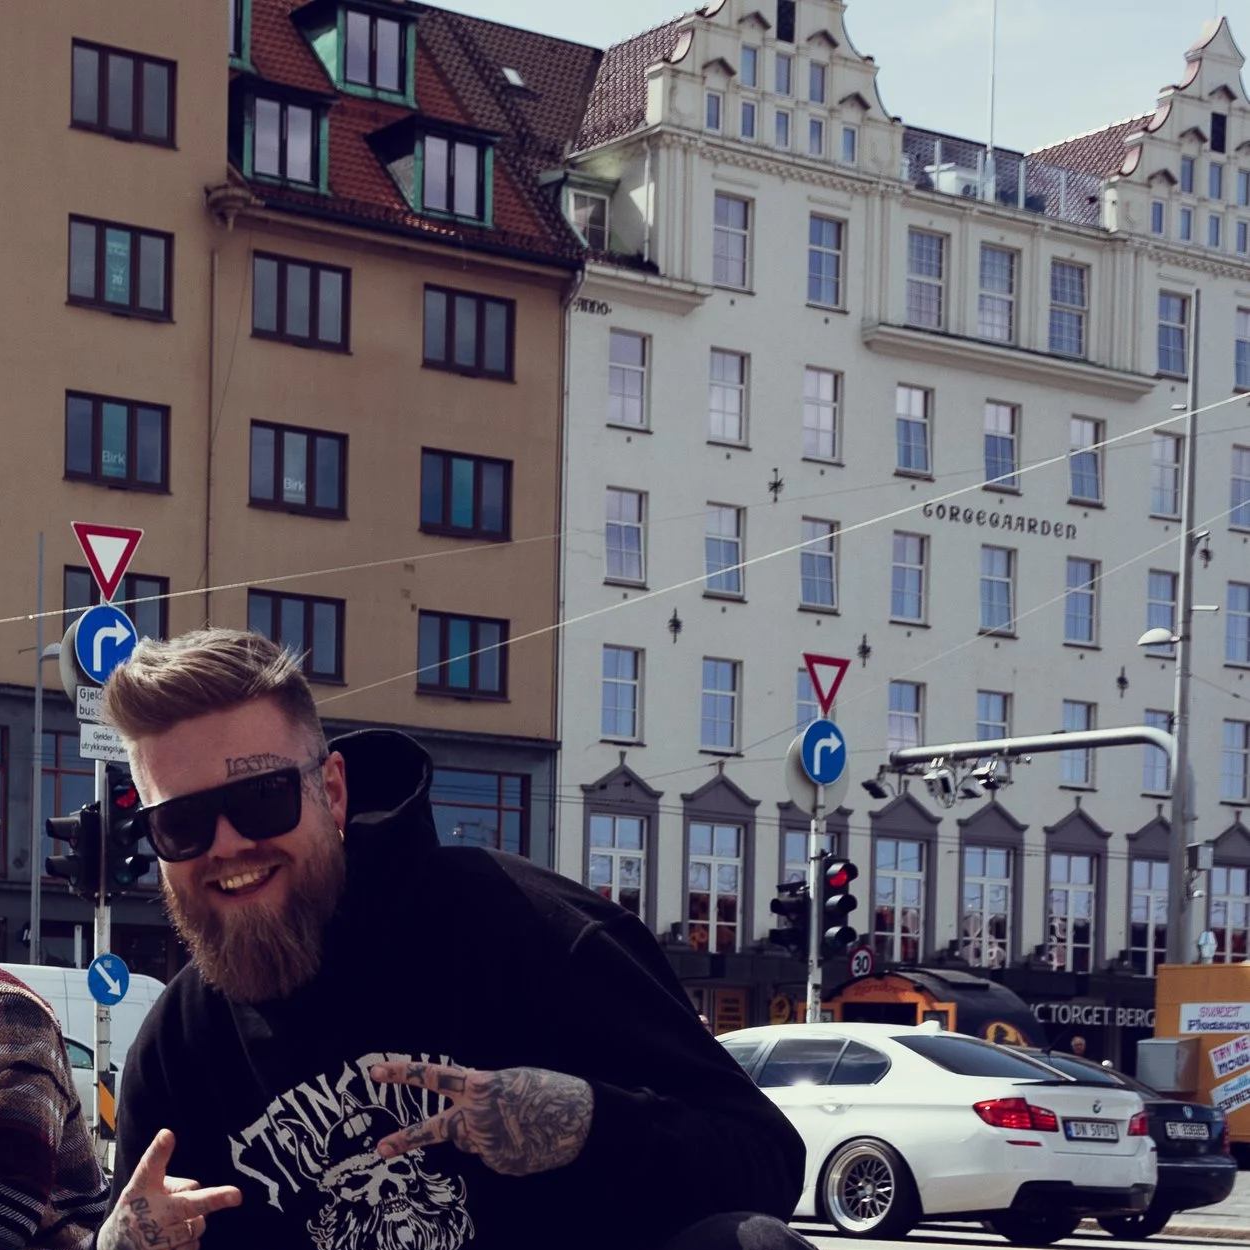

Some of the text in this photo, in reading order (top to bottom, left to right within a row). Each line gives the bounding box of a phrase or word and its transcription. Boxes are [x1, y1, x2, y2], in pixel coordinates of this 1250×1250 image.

[102, 450, 126, 464] Birk
[284, 477, 305, 491] Birk
[854, 955, 869, 974] 30
[1049, 1004, 1112, 1026] TORGET
